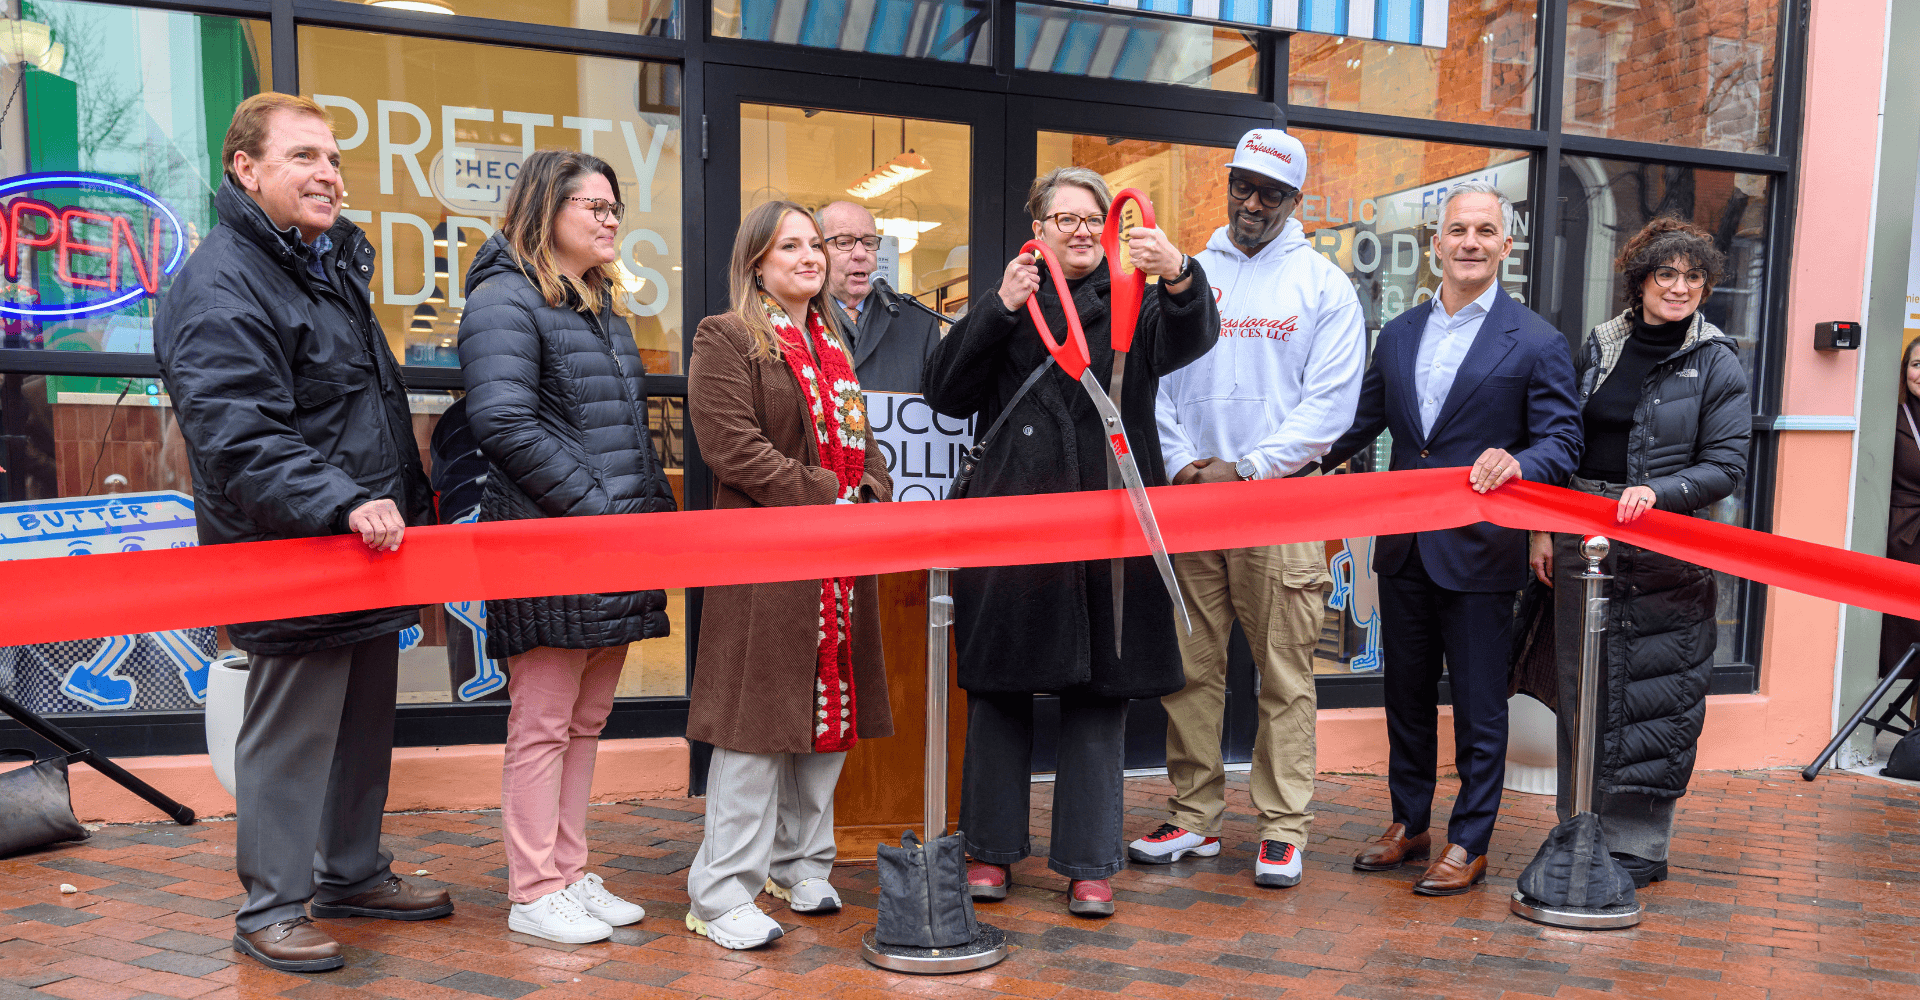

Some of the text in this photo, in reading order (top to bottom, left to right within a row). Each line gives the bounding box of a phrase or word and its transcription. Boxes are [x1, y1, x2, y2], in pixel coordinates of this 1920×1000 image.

[313, 94, 668, 213] PRETTY
[456, 158, 520, 180] HEC
[1243, 139, 1292, 165] Professionals
[1290, 194, 1529, 237] ELICATEN
[0, 201, 160, 294] PEN
[1315, 228, 1528, 283] RODUE
[1219, 310, 1298, 332] essionals
[1220, 328, 1291, 342] RVCES, LLC
[862, 395, 974, 436] UCCI
[17, 504, 148, 531] BUTTER
